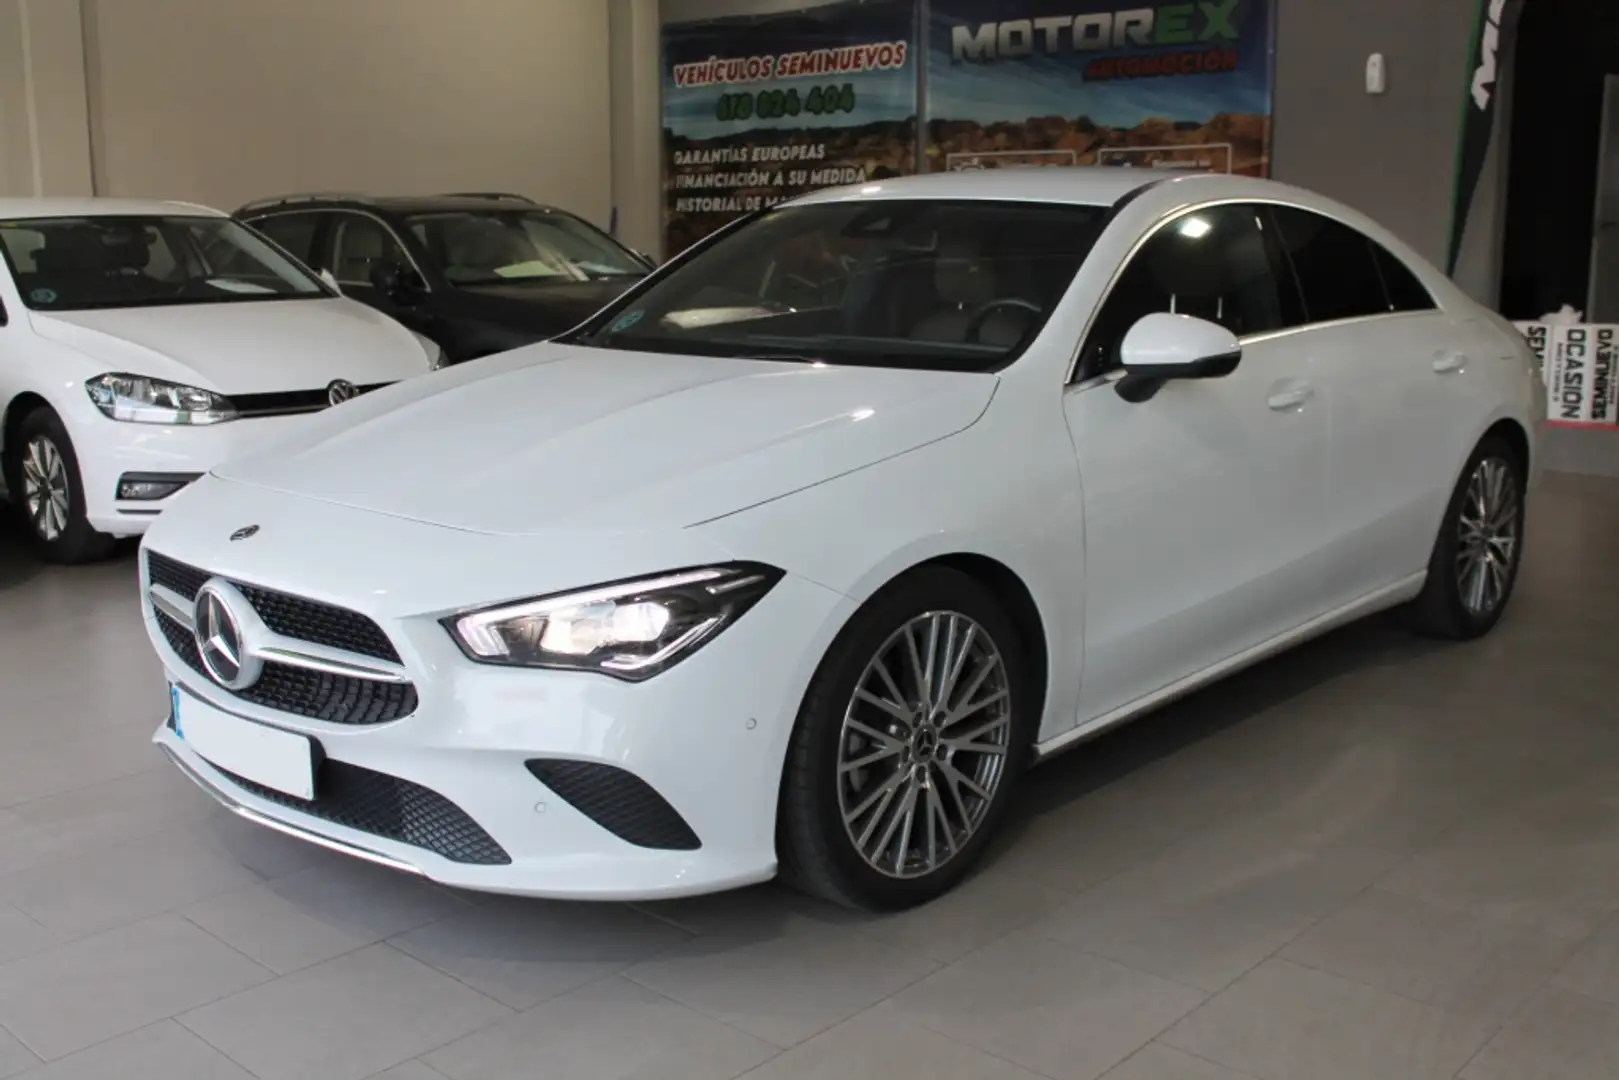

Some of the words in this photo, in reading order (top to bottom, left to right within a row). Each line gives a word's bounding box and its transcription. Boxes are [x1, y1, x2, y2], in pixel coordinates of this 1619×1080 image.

[951, 0, 1239, 61] MOTOREX
[674, 55, 772, 87] VEHÍCULOS
[776, 41, 907, 78] SEMINUEVOS
[1083, 48, 1239, 81] AUTOMOCIÓN
[674, 145, 748, 165] GARANTÍAS
[751, 144, 826, 162] EUROPEAS
[676, 168, 770, 188] FINANCIACIÓN
[773, 171, 785, 186] A
[788, 170, 808, 185] SU
[811, 167, 866, 185] MEDIDA
[676, 196, 742, 212] HISTORIAL
[745, 196, 761, 211] DE
